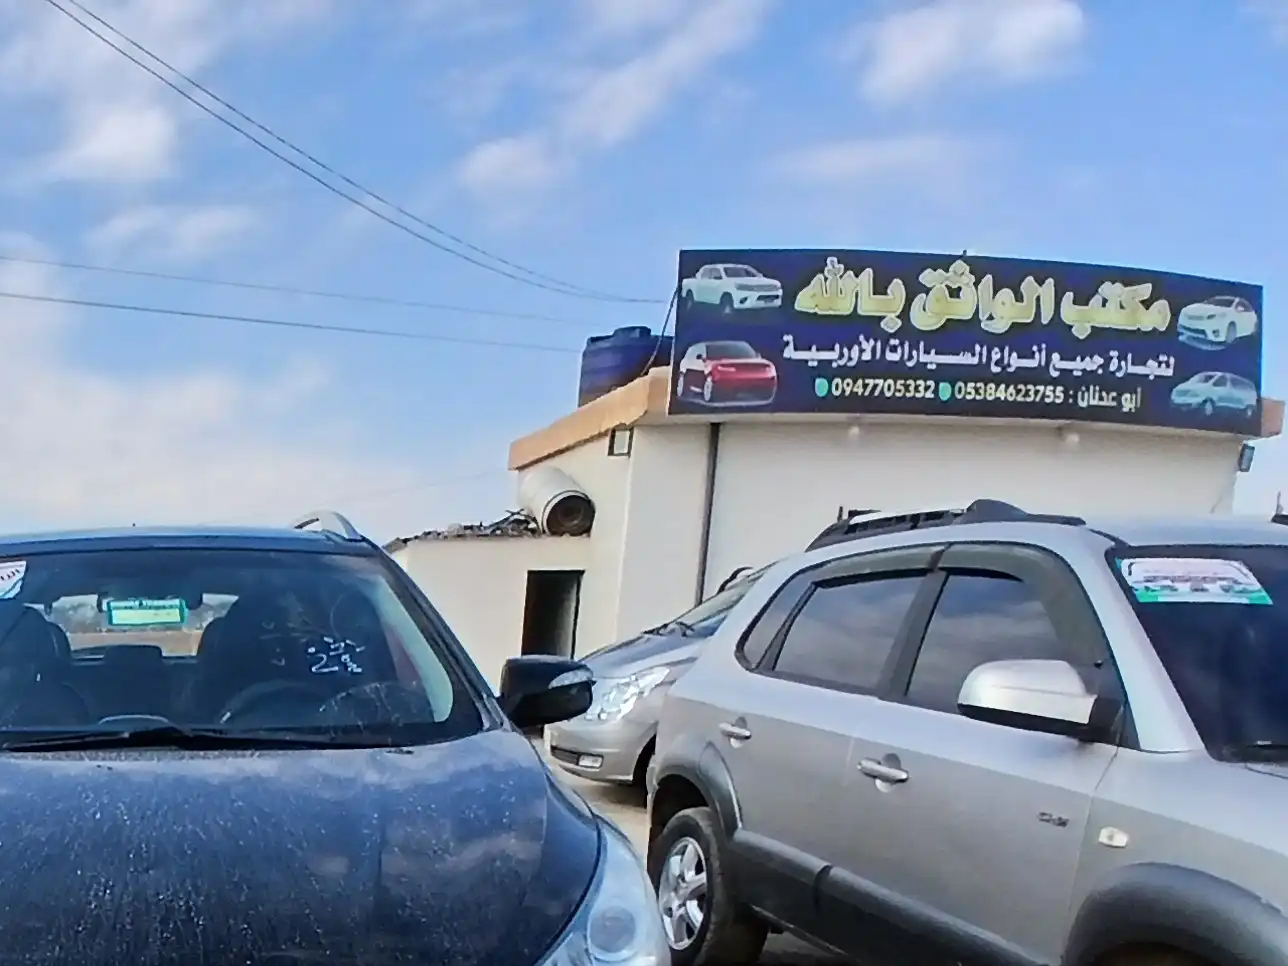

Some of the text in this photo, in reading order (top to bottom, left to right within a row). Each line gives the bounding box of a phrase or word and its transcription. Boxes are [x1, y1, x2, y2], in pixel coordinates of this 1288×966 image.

[794, 256, 1171, 340] مكتب الواثق بالله
[782, 334, 1175, 380] لتجارة جميع أنواع السيارات الأوربية
[831, 377, 935, 398] 0947705332
[954, 381, 1064, 404] 05384623755
[1077, 384, 1117, 408] عدنان
